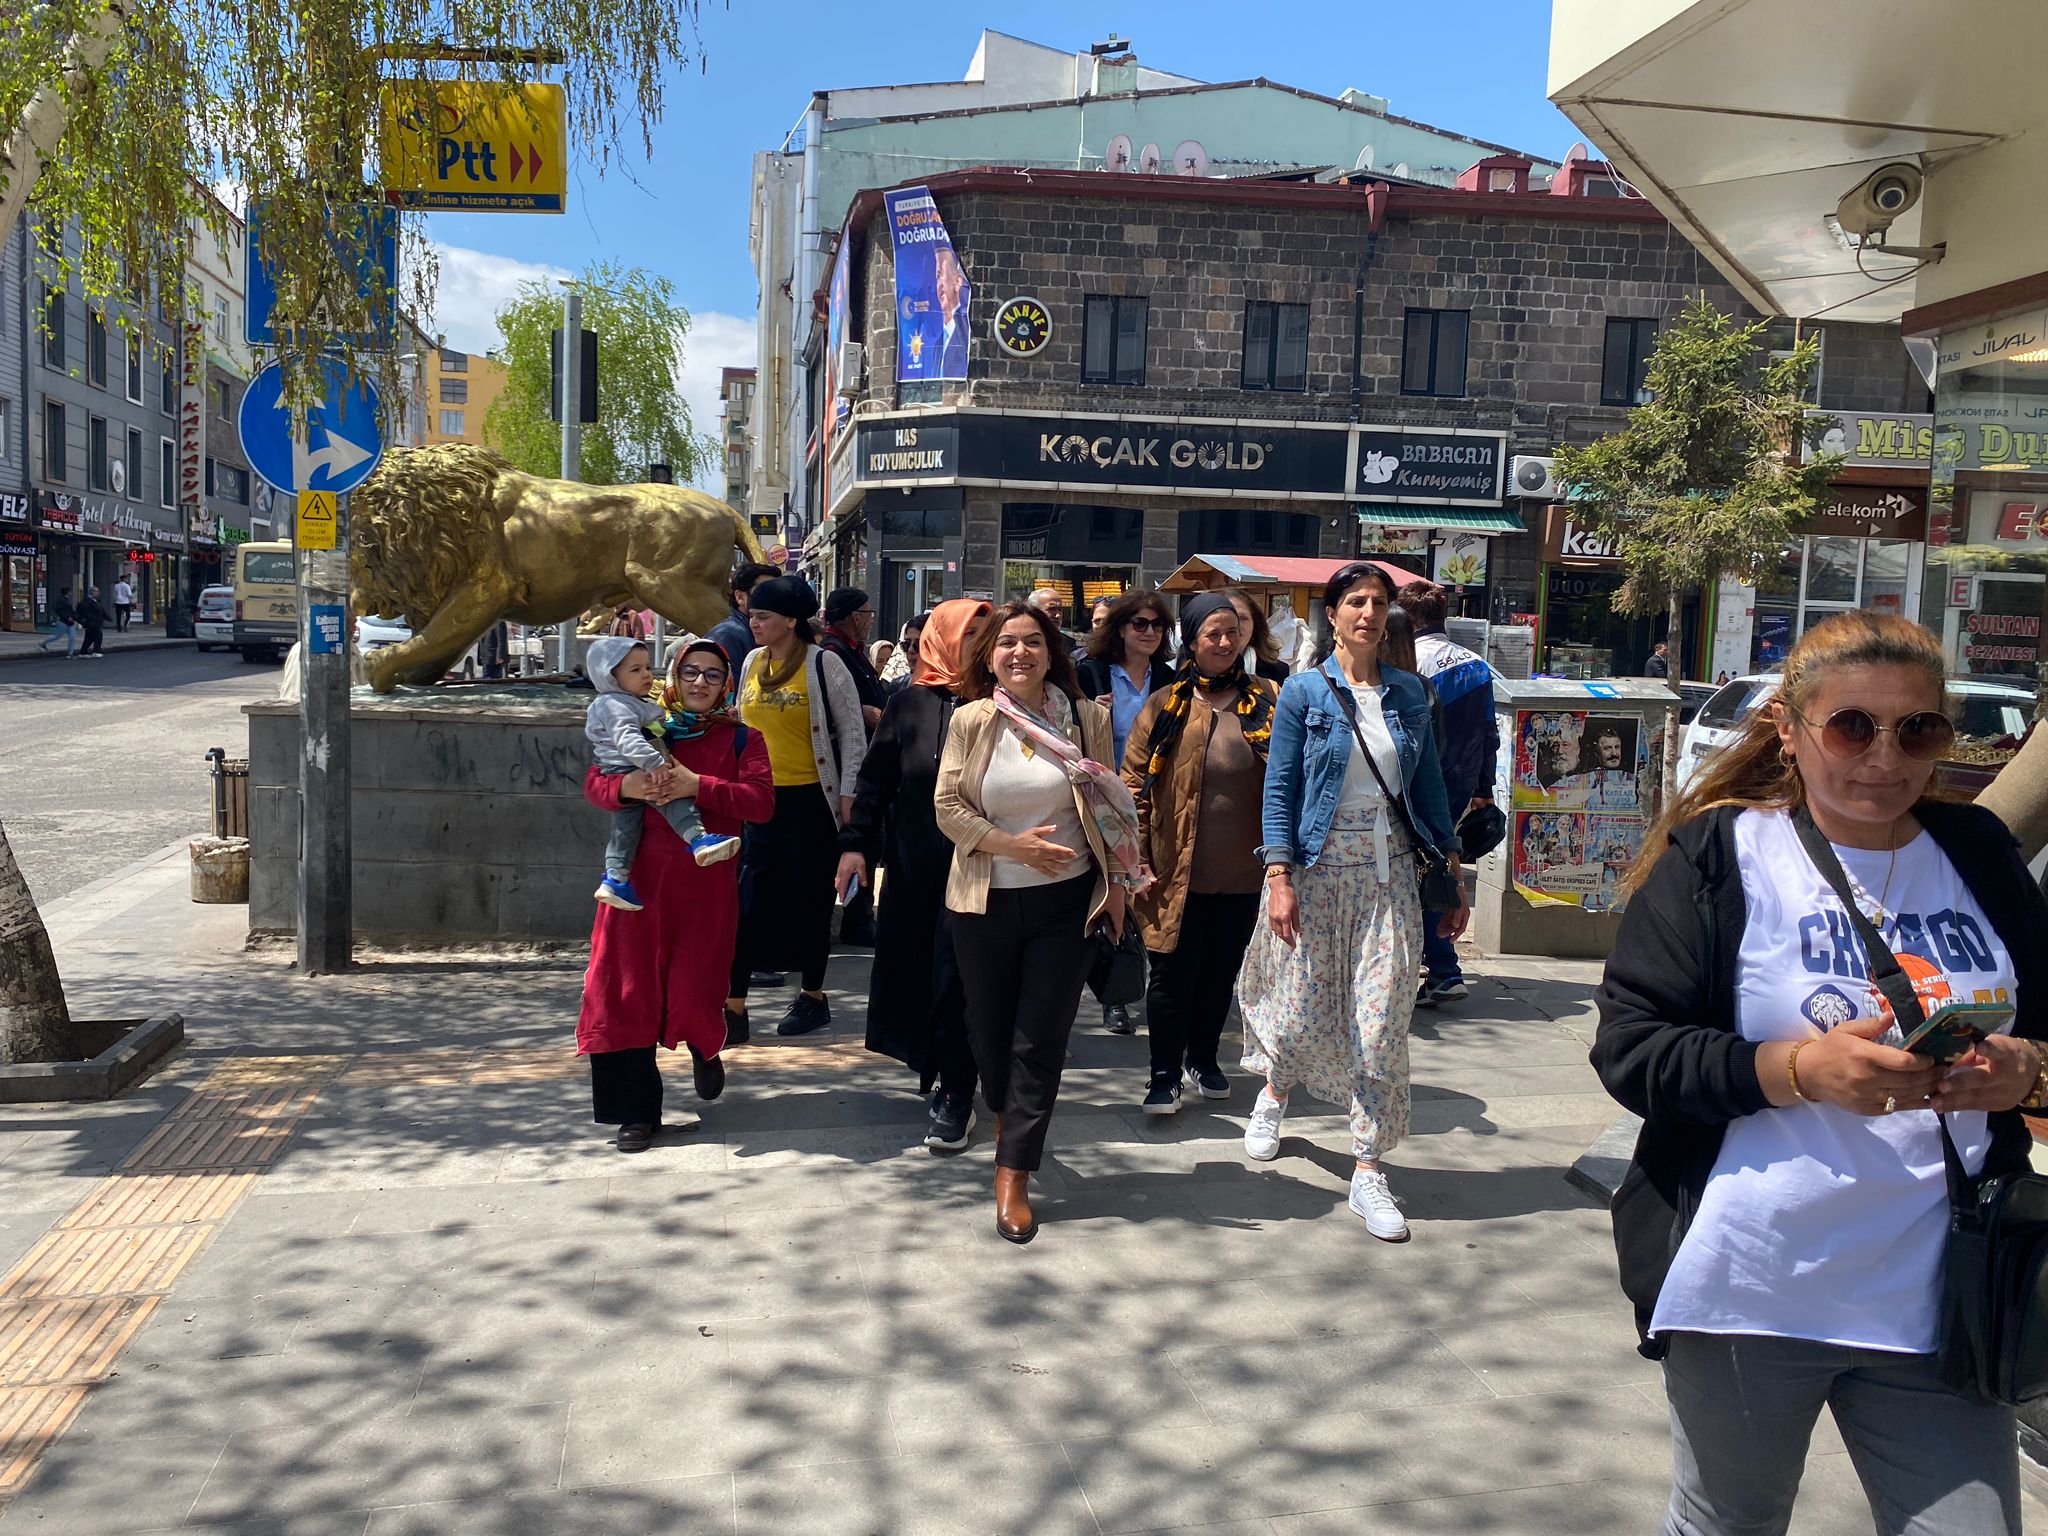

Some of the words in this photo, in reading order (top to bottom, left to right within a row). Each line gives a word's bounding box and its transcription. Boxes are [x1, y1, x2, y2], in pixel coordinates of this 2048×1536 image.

[437, 137, 498, 182] Ptt
[461, 194, 508, 206] hizmete
[510, 197, 536, 208] açık
[896, 210, 928, 227] DOĞRU
[898, 226, 931, 245] DOĞRU
[1003, 304, 1046, 327] KAHVE
[182, 323, 203, 386] HOEL
[895, 427, 918, 447] HAS
[181, 401, 200, 504] KAFKASYA
[869, 449, 945, 474] KUYUMCULUK
[1039, 432, 1161, 469] KOÇAK
[1169, 438, 1267, 471] GOLD
[1401, 443, 1493, 466] BABACAN
[1396, 468, 1493, 494] Kuruyemiş
[1952, 581, 1969, 603] E
[1966, 613, 2040, 637] SULTAN
